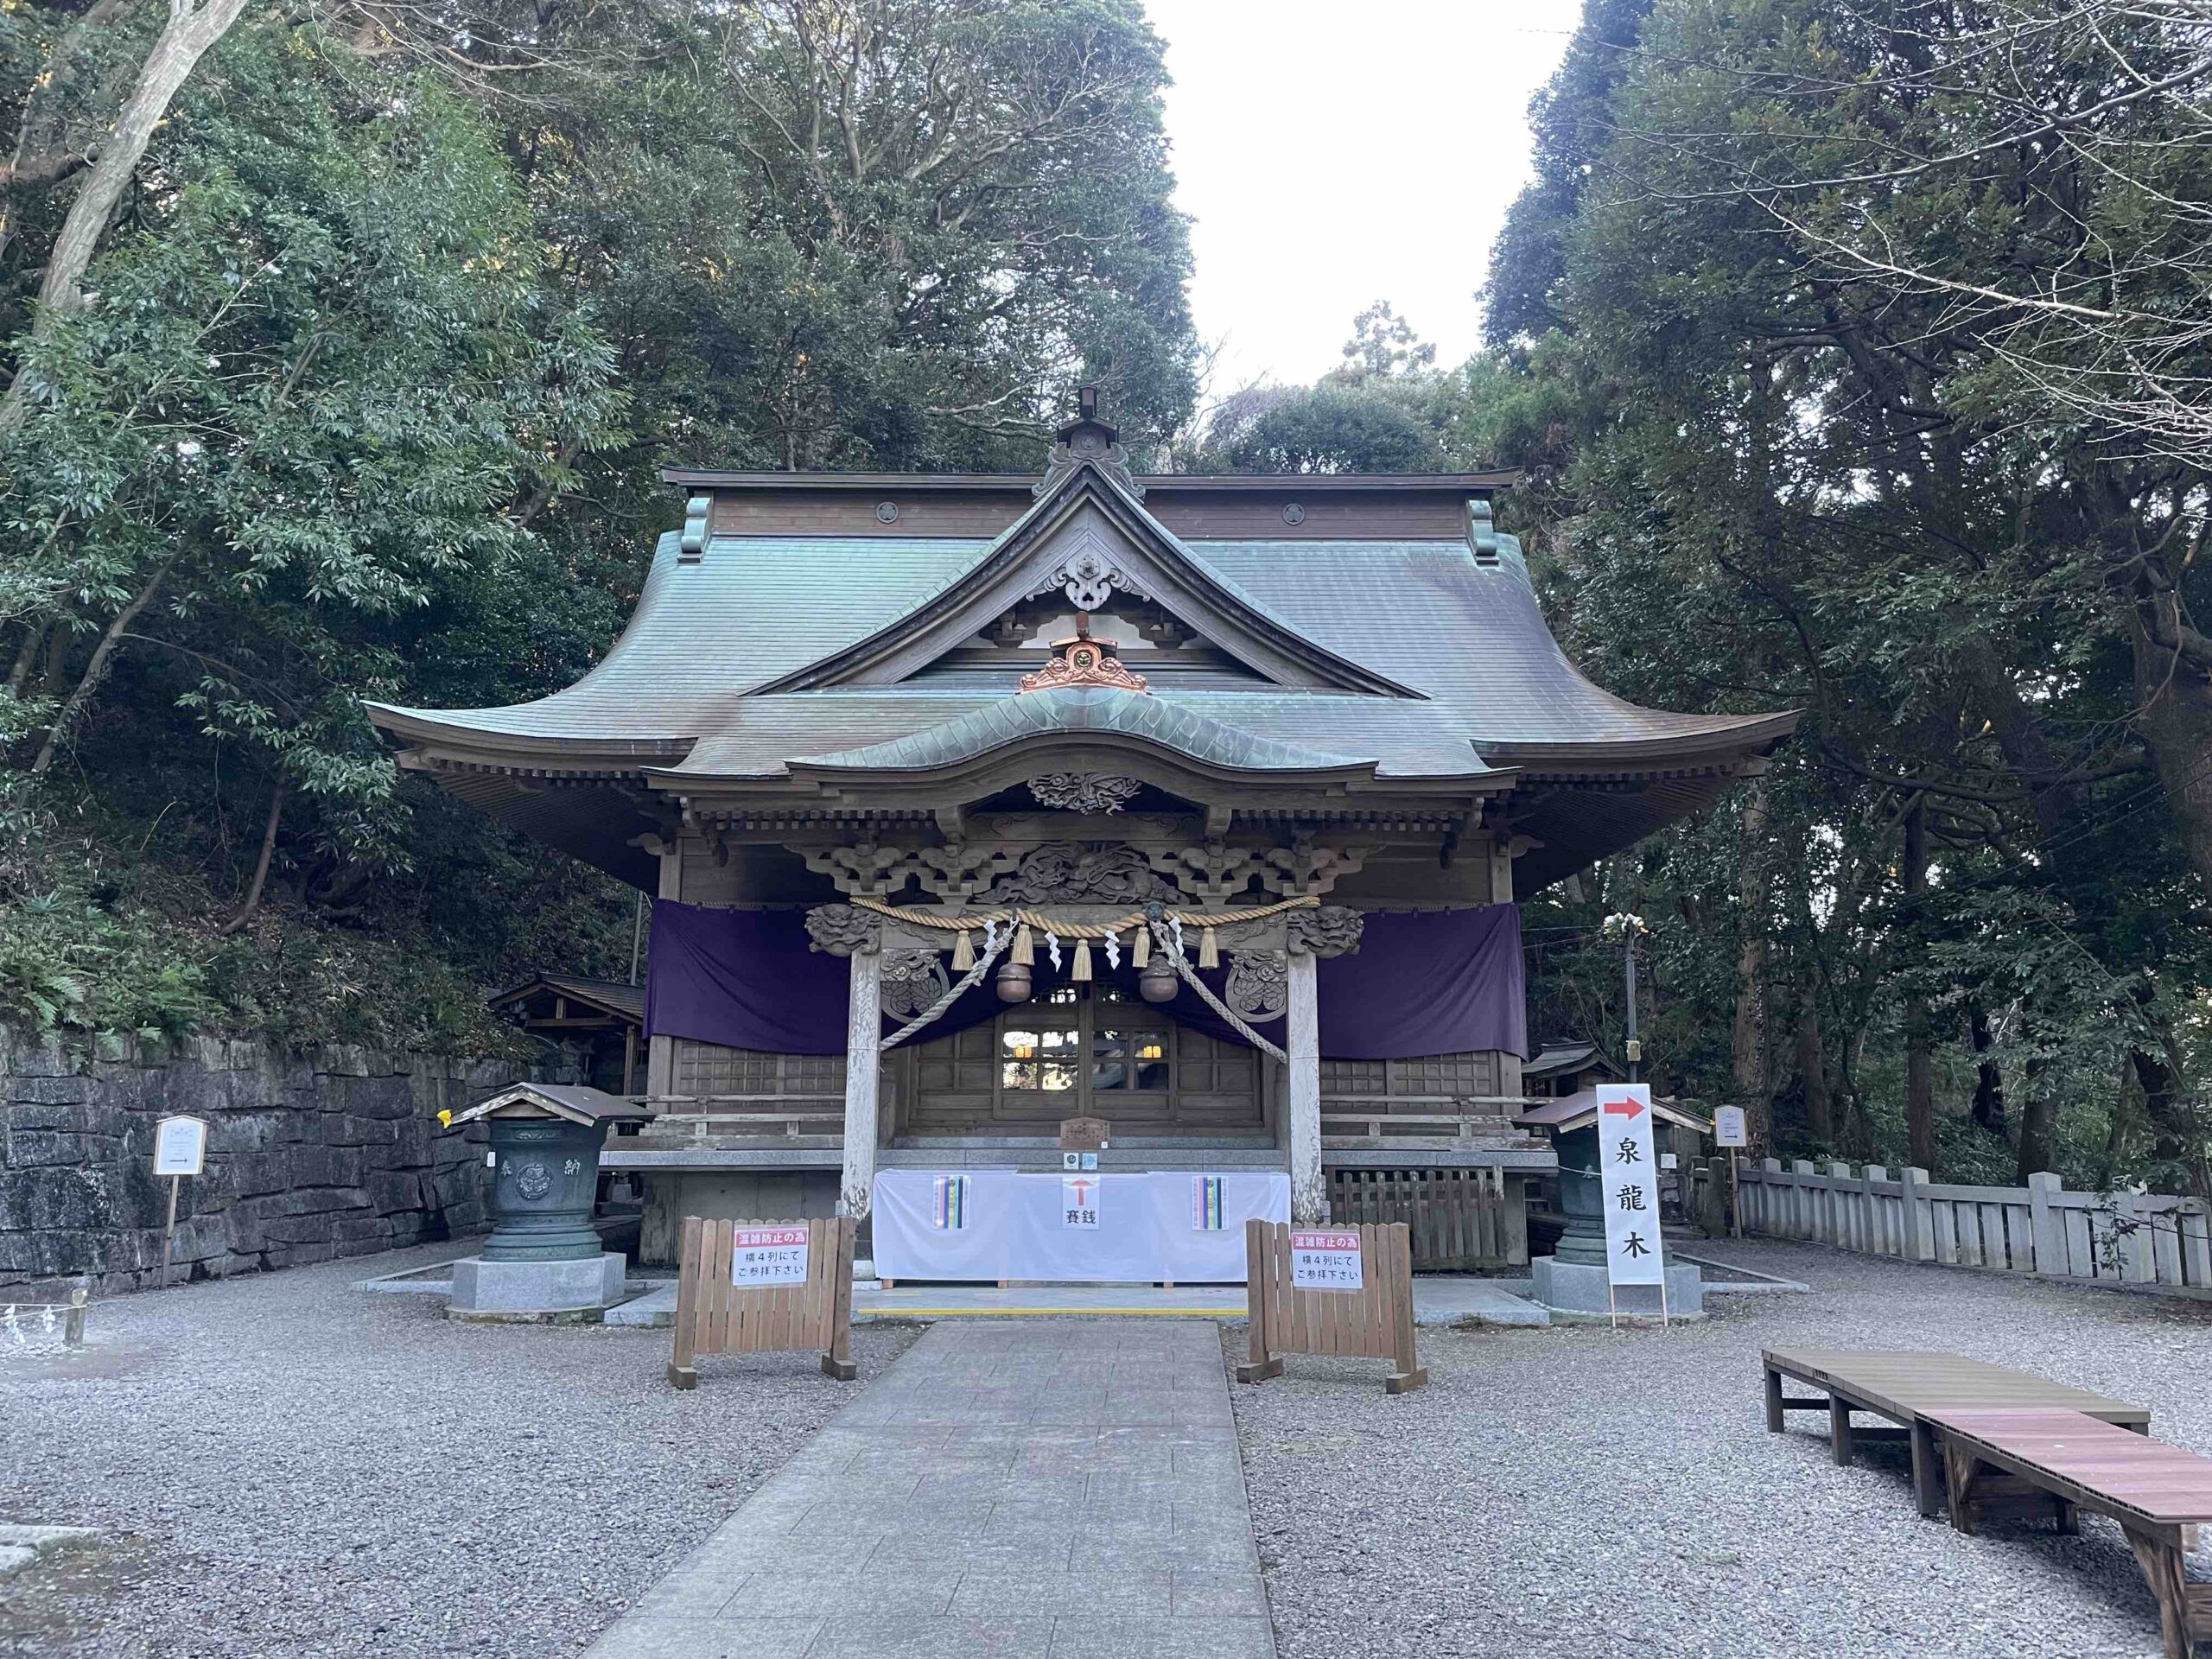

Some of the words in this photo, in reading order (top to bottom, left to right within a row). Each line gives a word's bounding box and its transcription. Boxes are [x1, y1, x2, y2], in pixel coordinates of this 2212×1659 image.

[1616, 1137, 1651, 1259] 泉龍木
[1066, 1210, 1096, 1224] 賽銭
[739, 1232, 805, 1245] 混雑防止の為
[1294, 1236, 1357, 1248] 混雑防止の為
[738, 1265, 804, 1277] ご参拝下さい
[1298, 1270, 1358, 1281] ご参拝下さい
